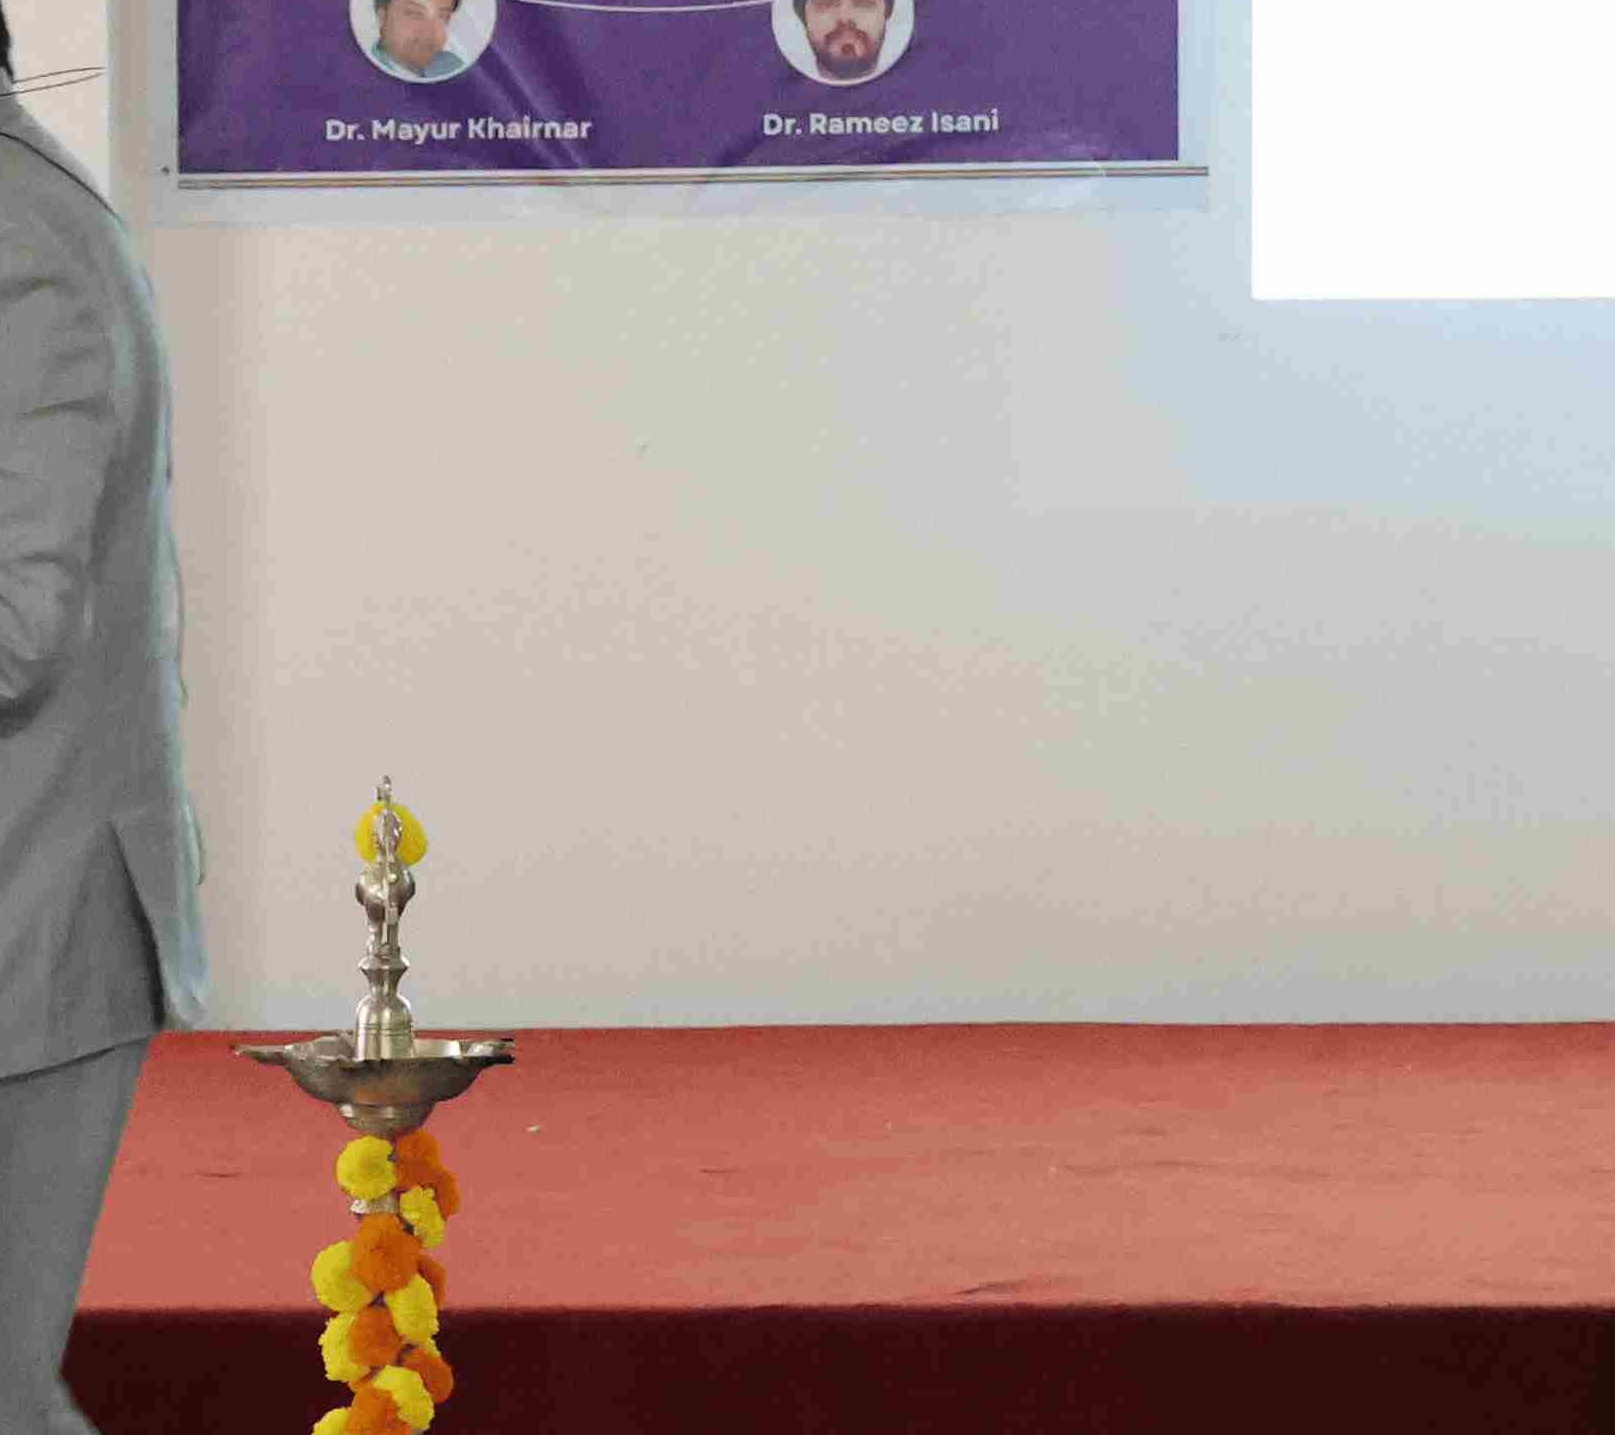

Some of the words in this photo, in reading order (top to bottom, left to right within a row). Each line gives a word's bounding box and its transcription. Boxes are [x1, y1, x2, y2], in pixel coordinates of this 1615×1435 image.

[325, 118, 365, 141] Dr.
[371, 118, 460, 146] Mayur
[468, 116, 593, 140] Khairnar
[763, 113, 804, 136] Dr.
[809, 112, 924, 135] Rameez
[930, 108, 1000, 133] Isani
